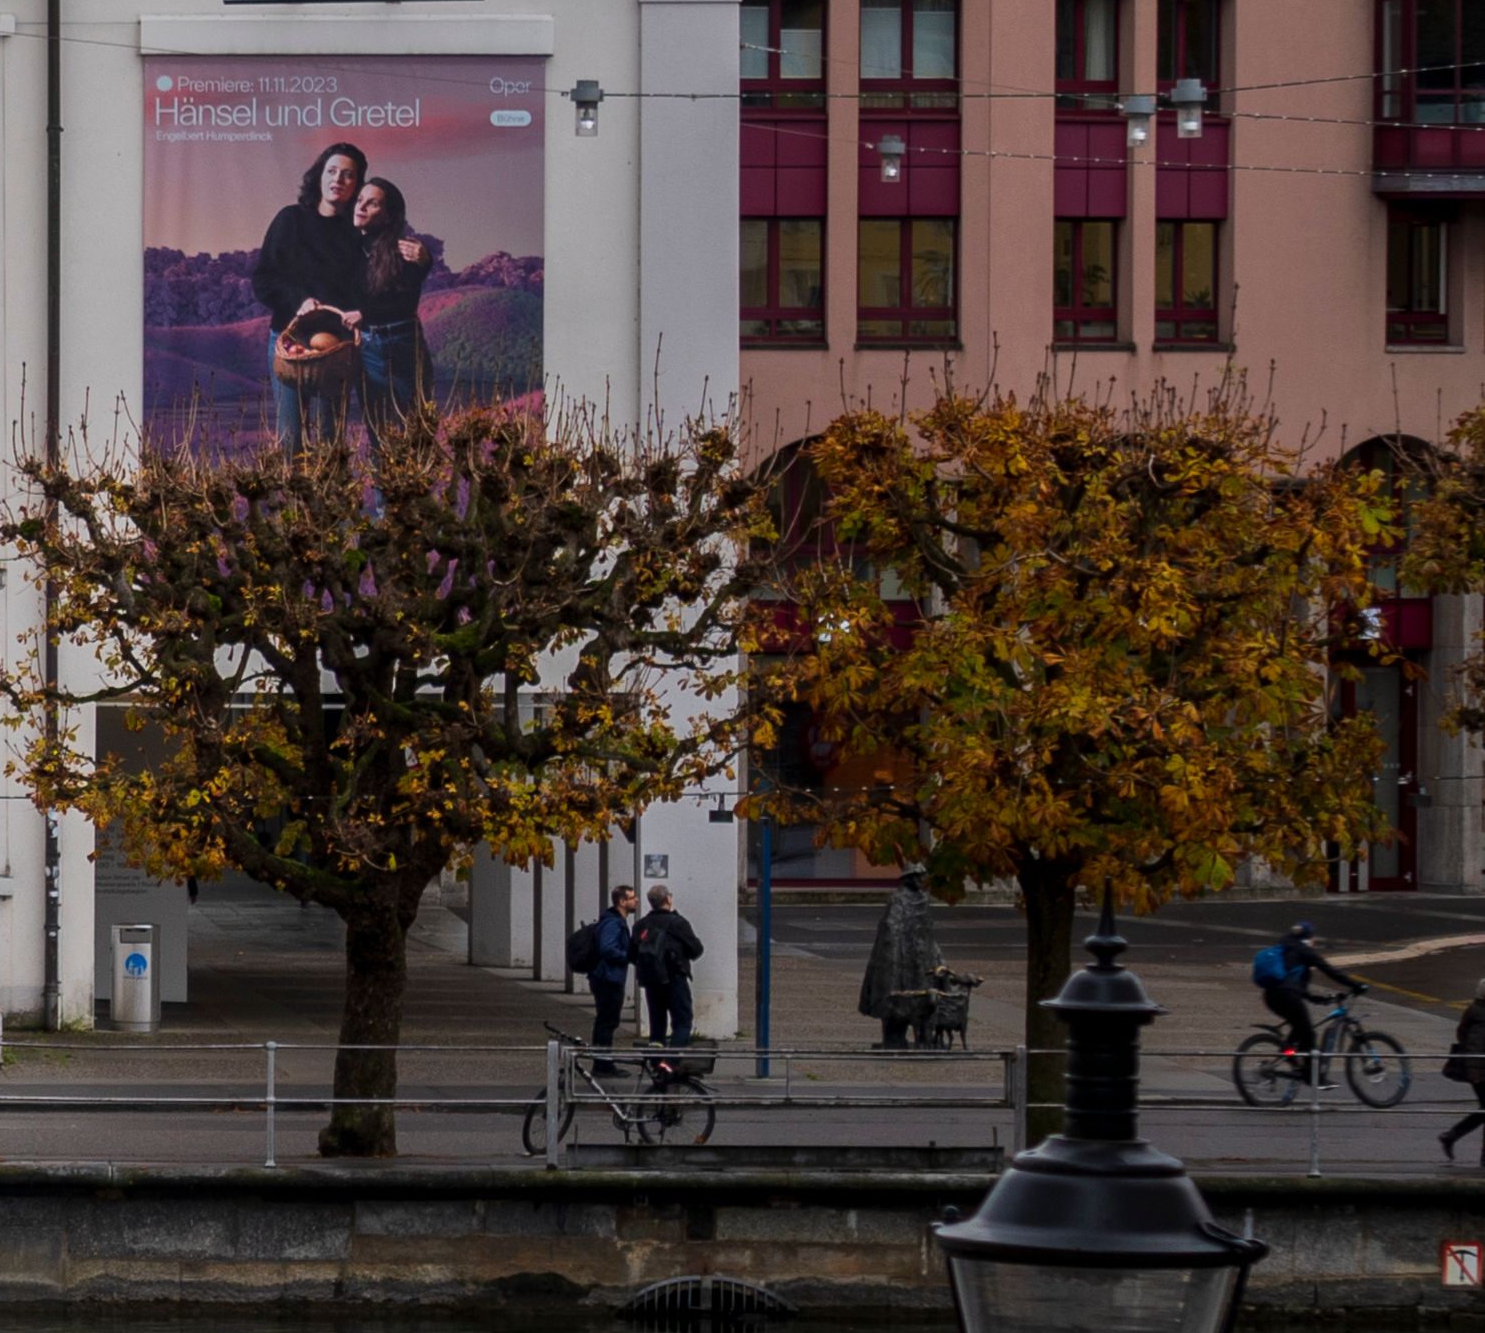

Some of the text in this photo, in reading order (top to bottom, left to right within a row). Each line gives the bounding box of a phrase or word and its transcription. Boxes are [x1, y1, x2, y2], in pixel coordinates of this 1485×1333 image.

[177, 76, 338, 94] Premiere: 11.11.2023
[489, 77, 532, 97] Oper
[155, 97, 421, 127] Hänsel und Gretel
[156, 130, 273, 142] Engelbert Humperdinck
